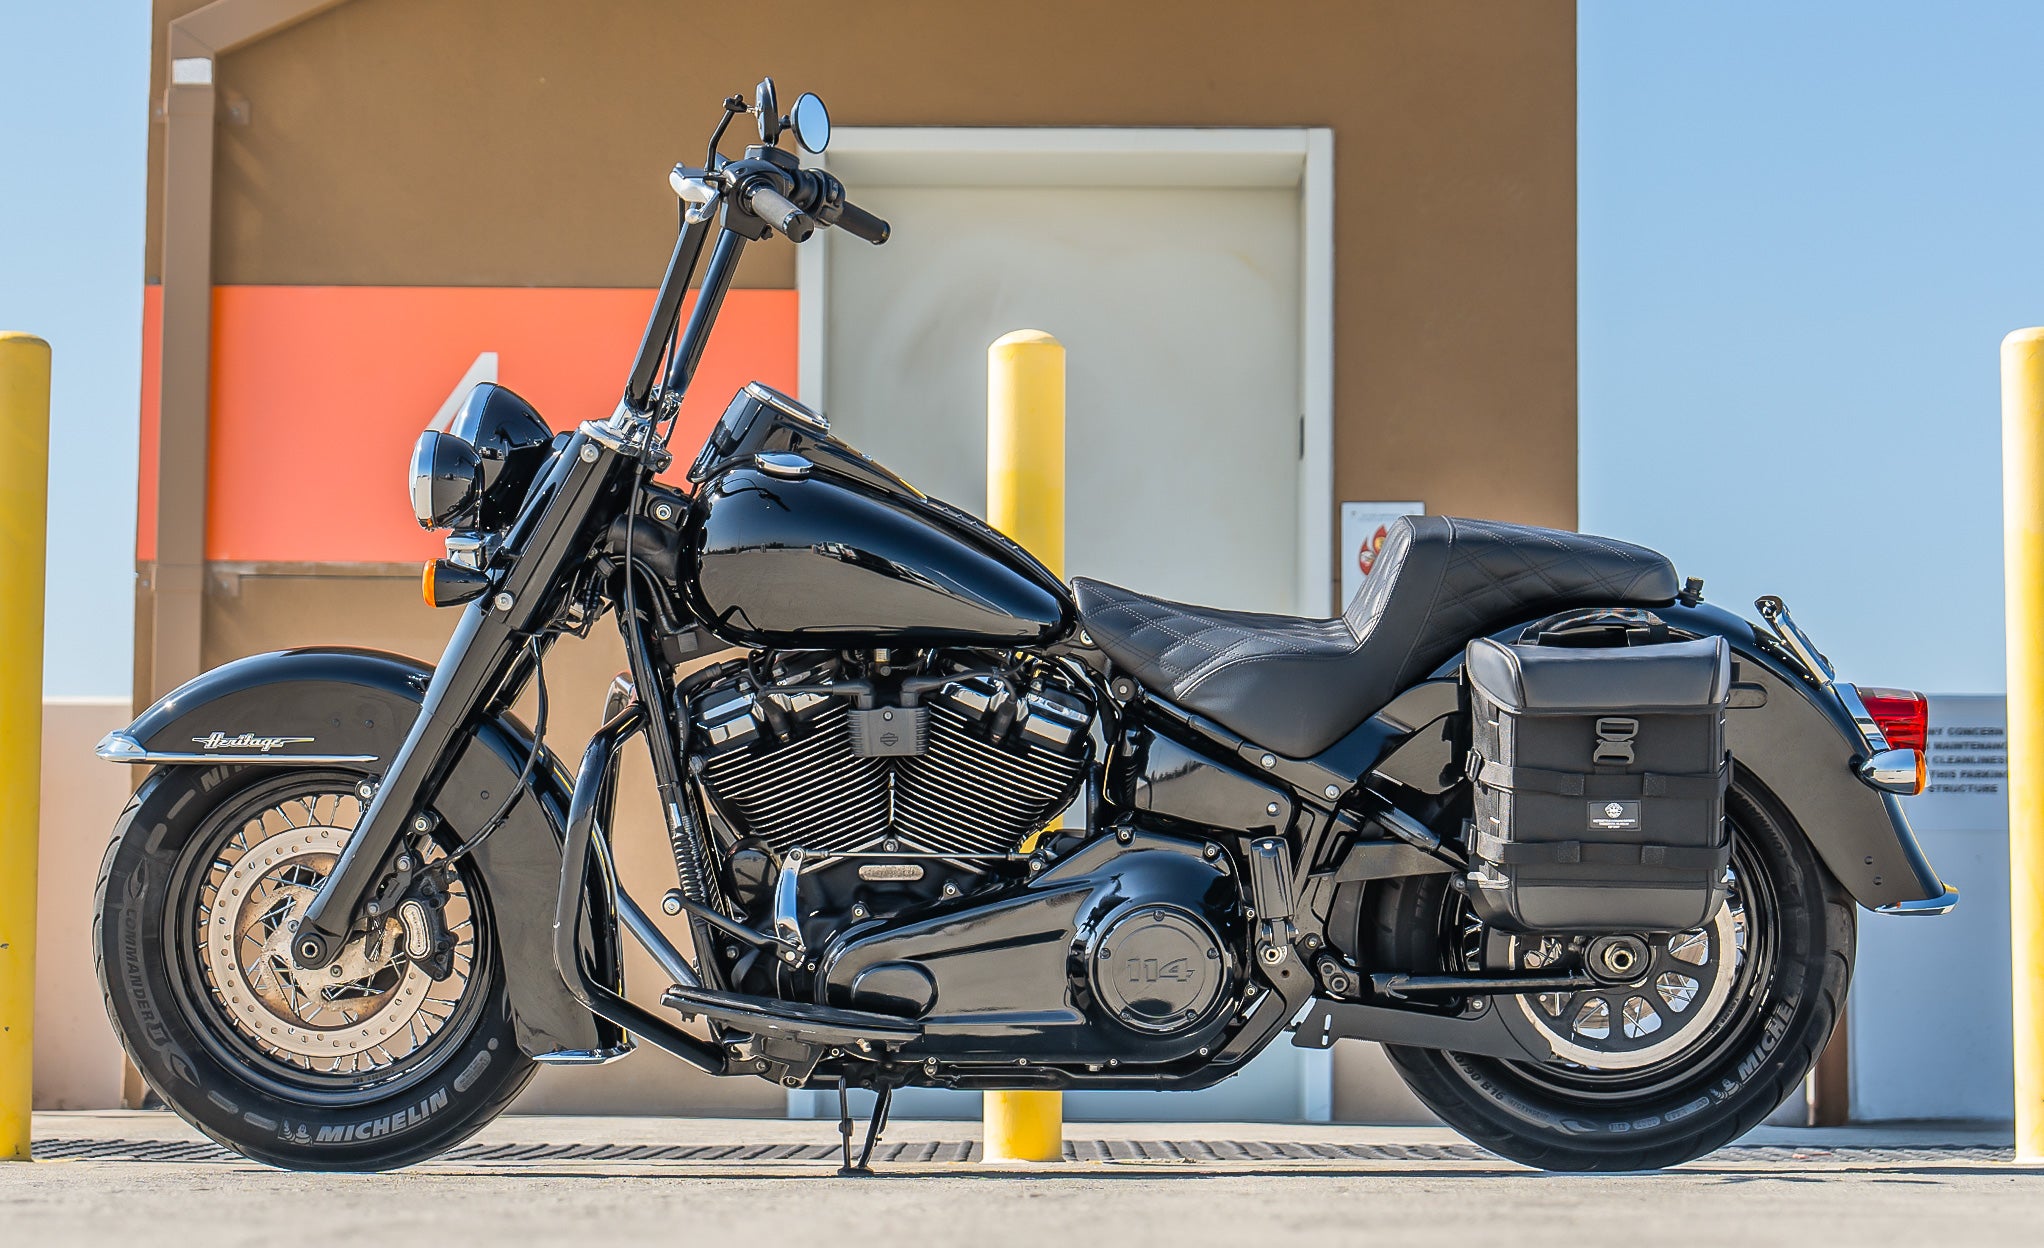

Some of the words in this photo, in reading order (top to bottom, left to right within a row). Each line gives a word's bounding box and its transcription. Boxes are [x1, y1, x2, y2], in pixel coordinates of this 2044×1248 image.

[202, 731, 285, 752] Heritage
[1928, 727, 1943, 736] NY
[1947, 726, 2004, 736] CONCERN
[1933, 741, 2007, 750] MAINTENANC
[1932, 755, 2008, 764] CLEANLINES
[126, 908, 155, 1021] COMMANDER
[1127, 957, 1196, 983] 114
[1737, 977, 1804, 1081] MICHEL
[315, 1087, 449, 1143] MICHELIN
